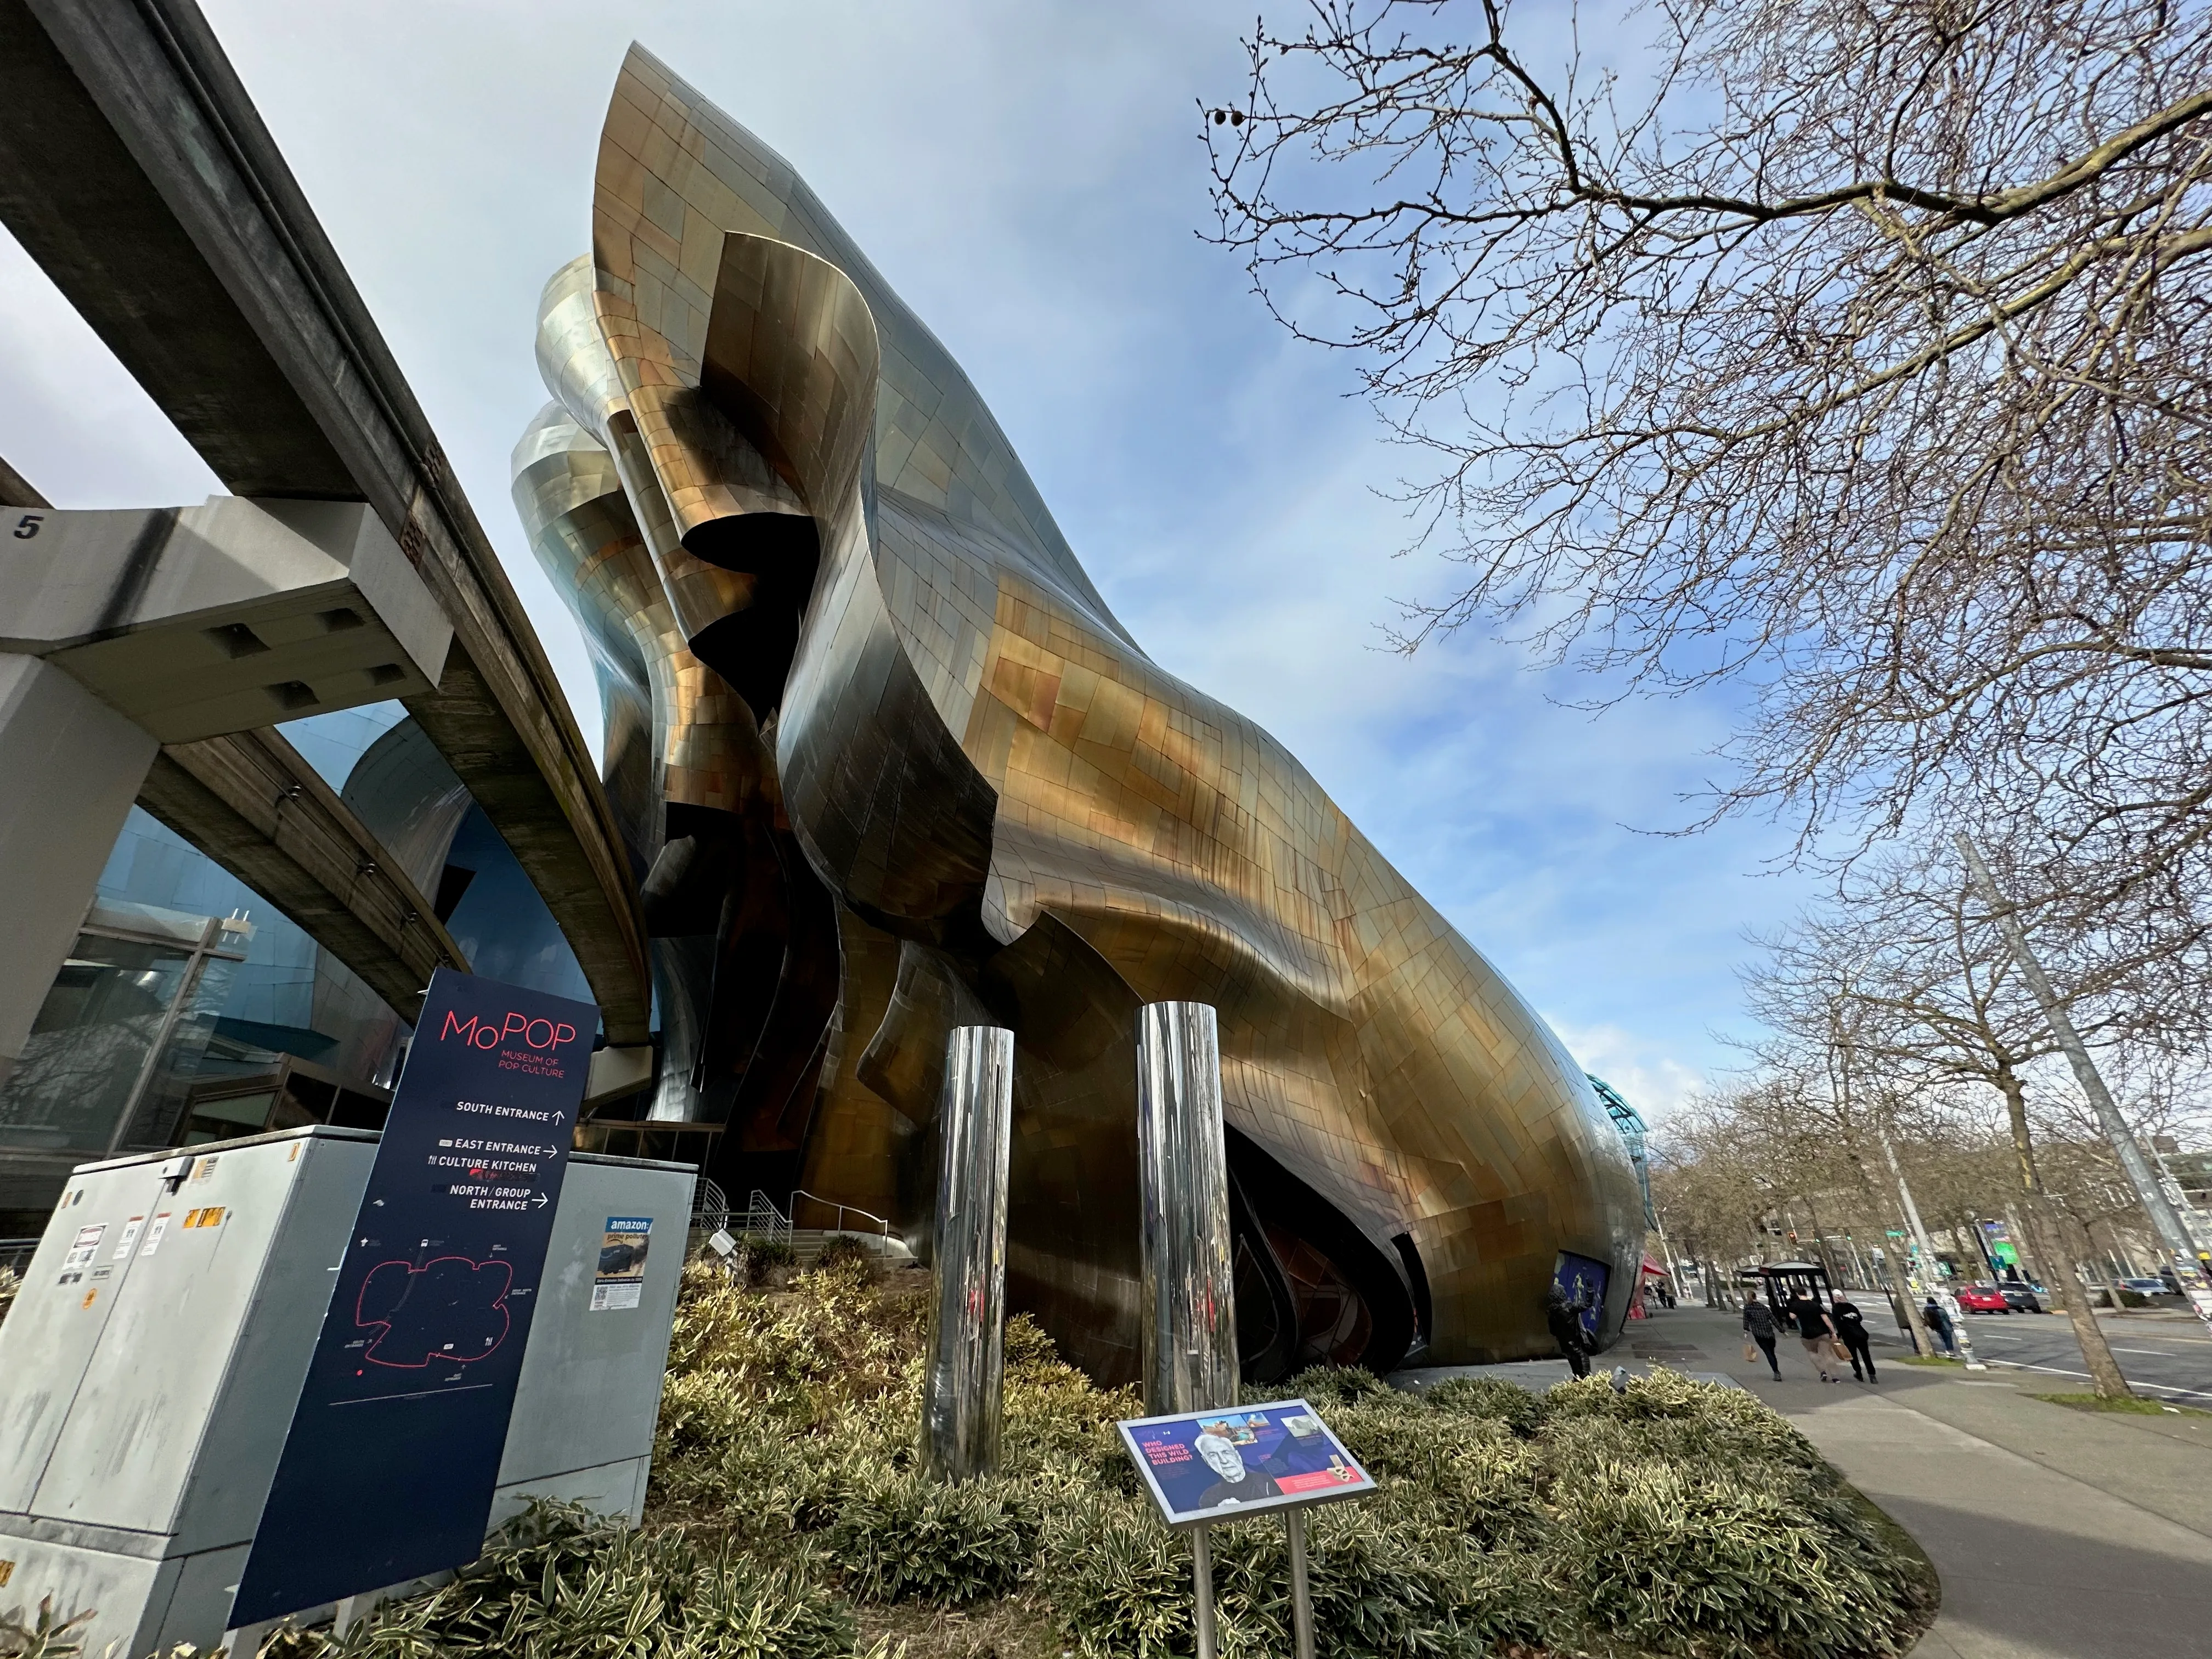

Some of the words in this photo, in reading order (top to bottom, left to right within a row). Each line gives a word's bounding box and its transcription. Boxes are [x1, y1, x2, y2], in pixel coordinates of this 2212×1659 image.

[14, 515, 44, 539] 5
[440, 1010, 576, 1051] MoPOP
[501, 1050, 544, 1064] MUSEUM
[545, 1058, 560, 1066] OF
[498, 1060, 520, 1070] POP
[521, 1064, 565, 1079] CULTURE
[456, 1101, 493, 1114] SOUTH
[495, 1107, 550, 1121] ENTRANCE
[455, 1138, 483, 1150] EAST
[485, 1143, 541, 1155] ENTRANCE
[438, 1156, 488, 1169] CULTURE
[491, 1160, 537, 1173] KITCHEN
[470, 1199, 528, 1211] ENTRANCE
[1145, 1443, 1185, 1453] DESIGNED
[1151, 1454, 1193, 1465] BUILDING?
